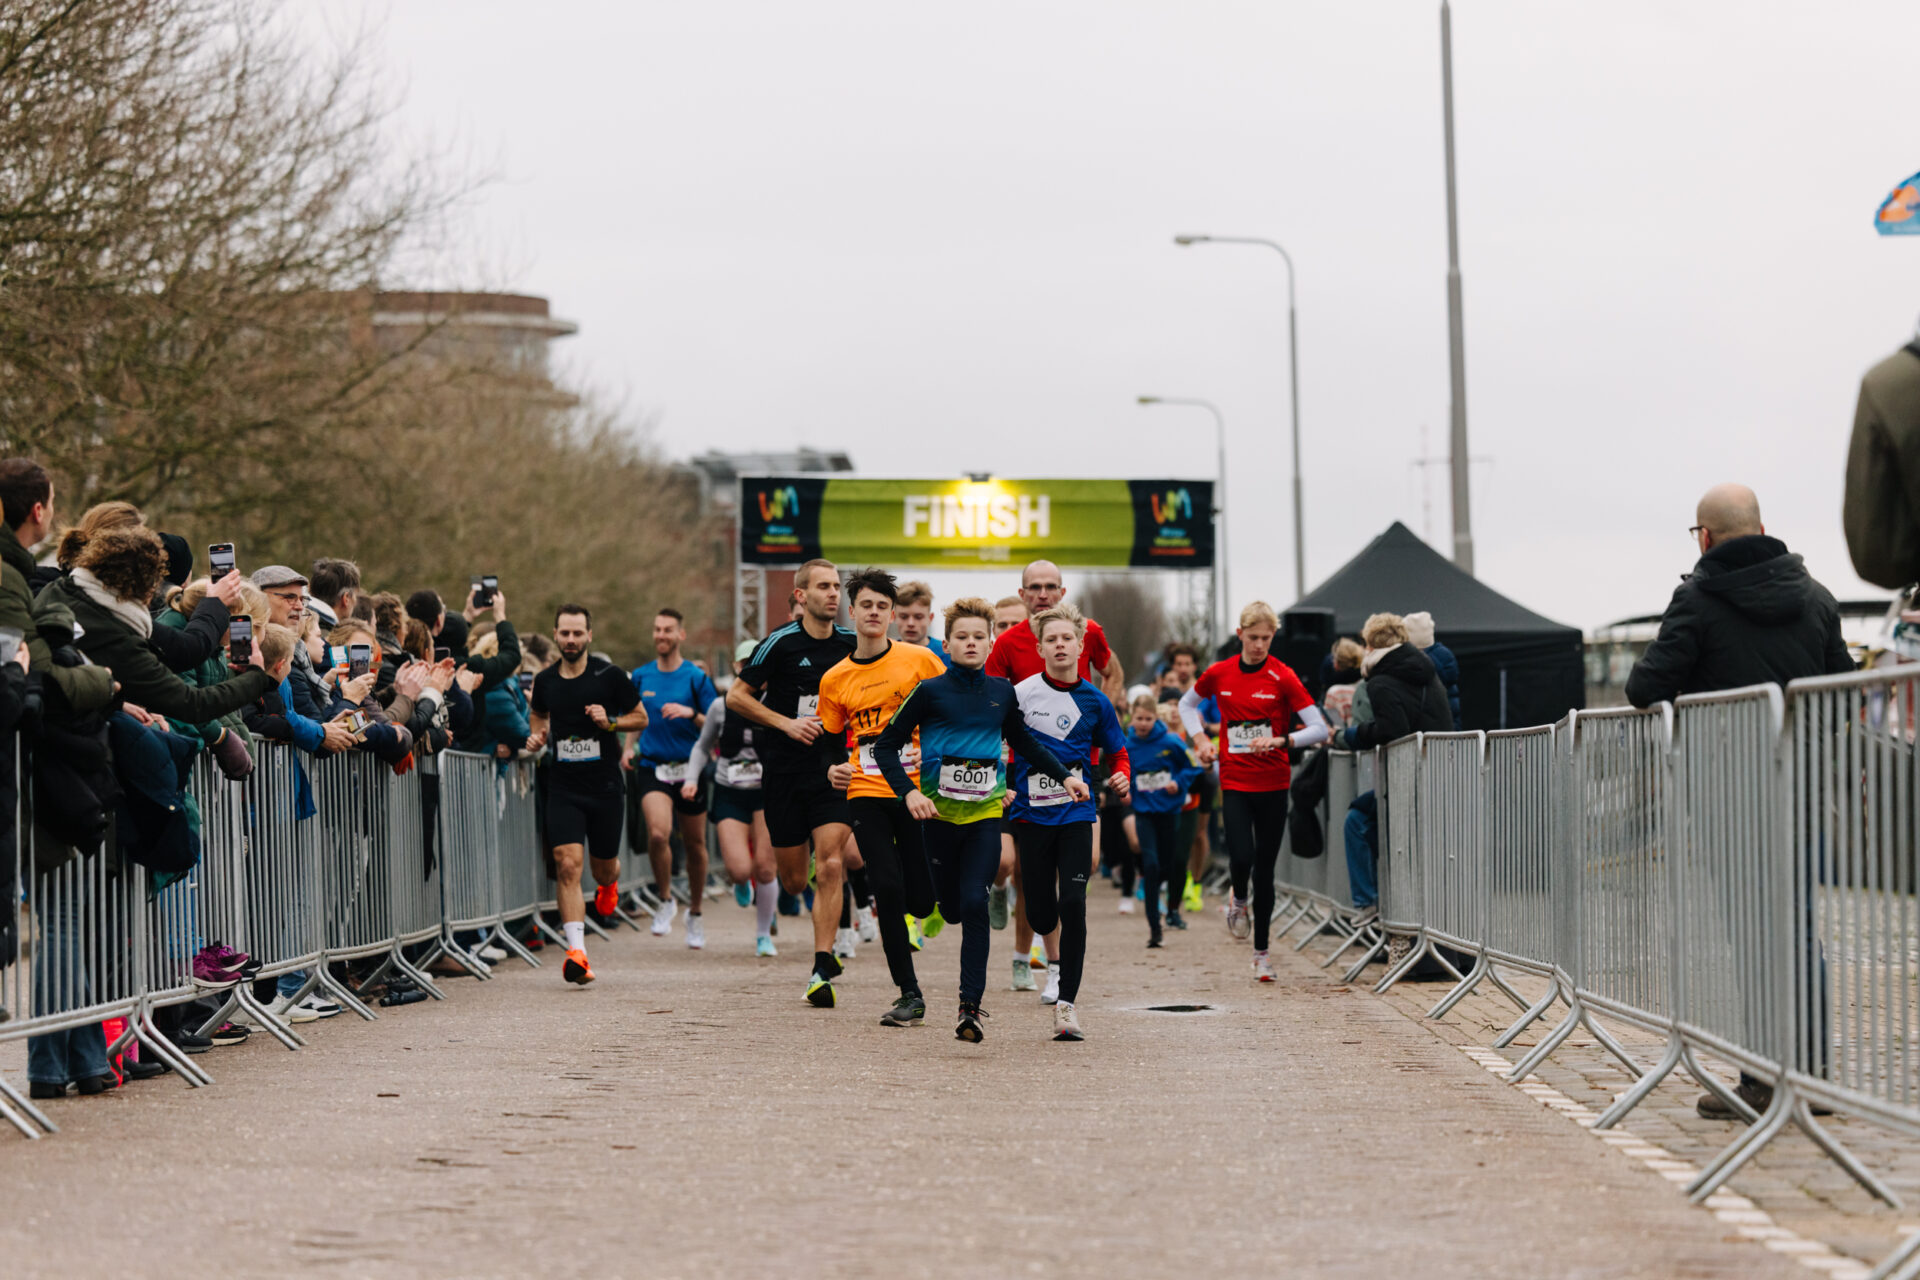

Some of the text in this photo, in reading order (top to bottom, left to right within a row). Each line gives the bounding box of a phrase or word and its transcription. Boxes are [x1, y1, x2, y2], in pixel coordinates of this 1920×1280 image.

[903, 494, 1050, 538] FINISH
[855, 707, 882, 728] 117
[562, 743, 591, 754] 4204
[953, 769, 988, 784] 6001
